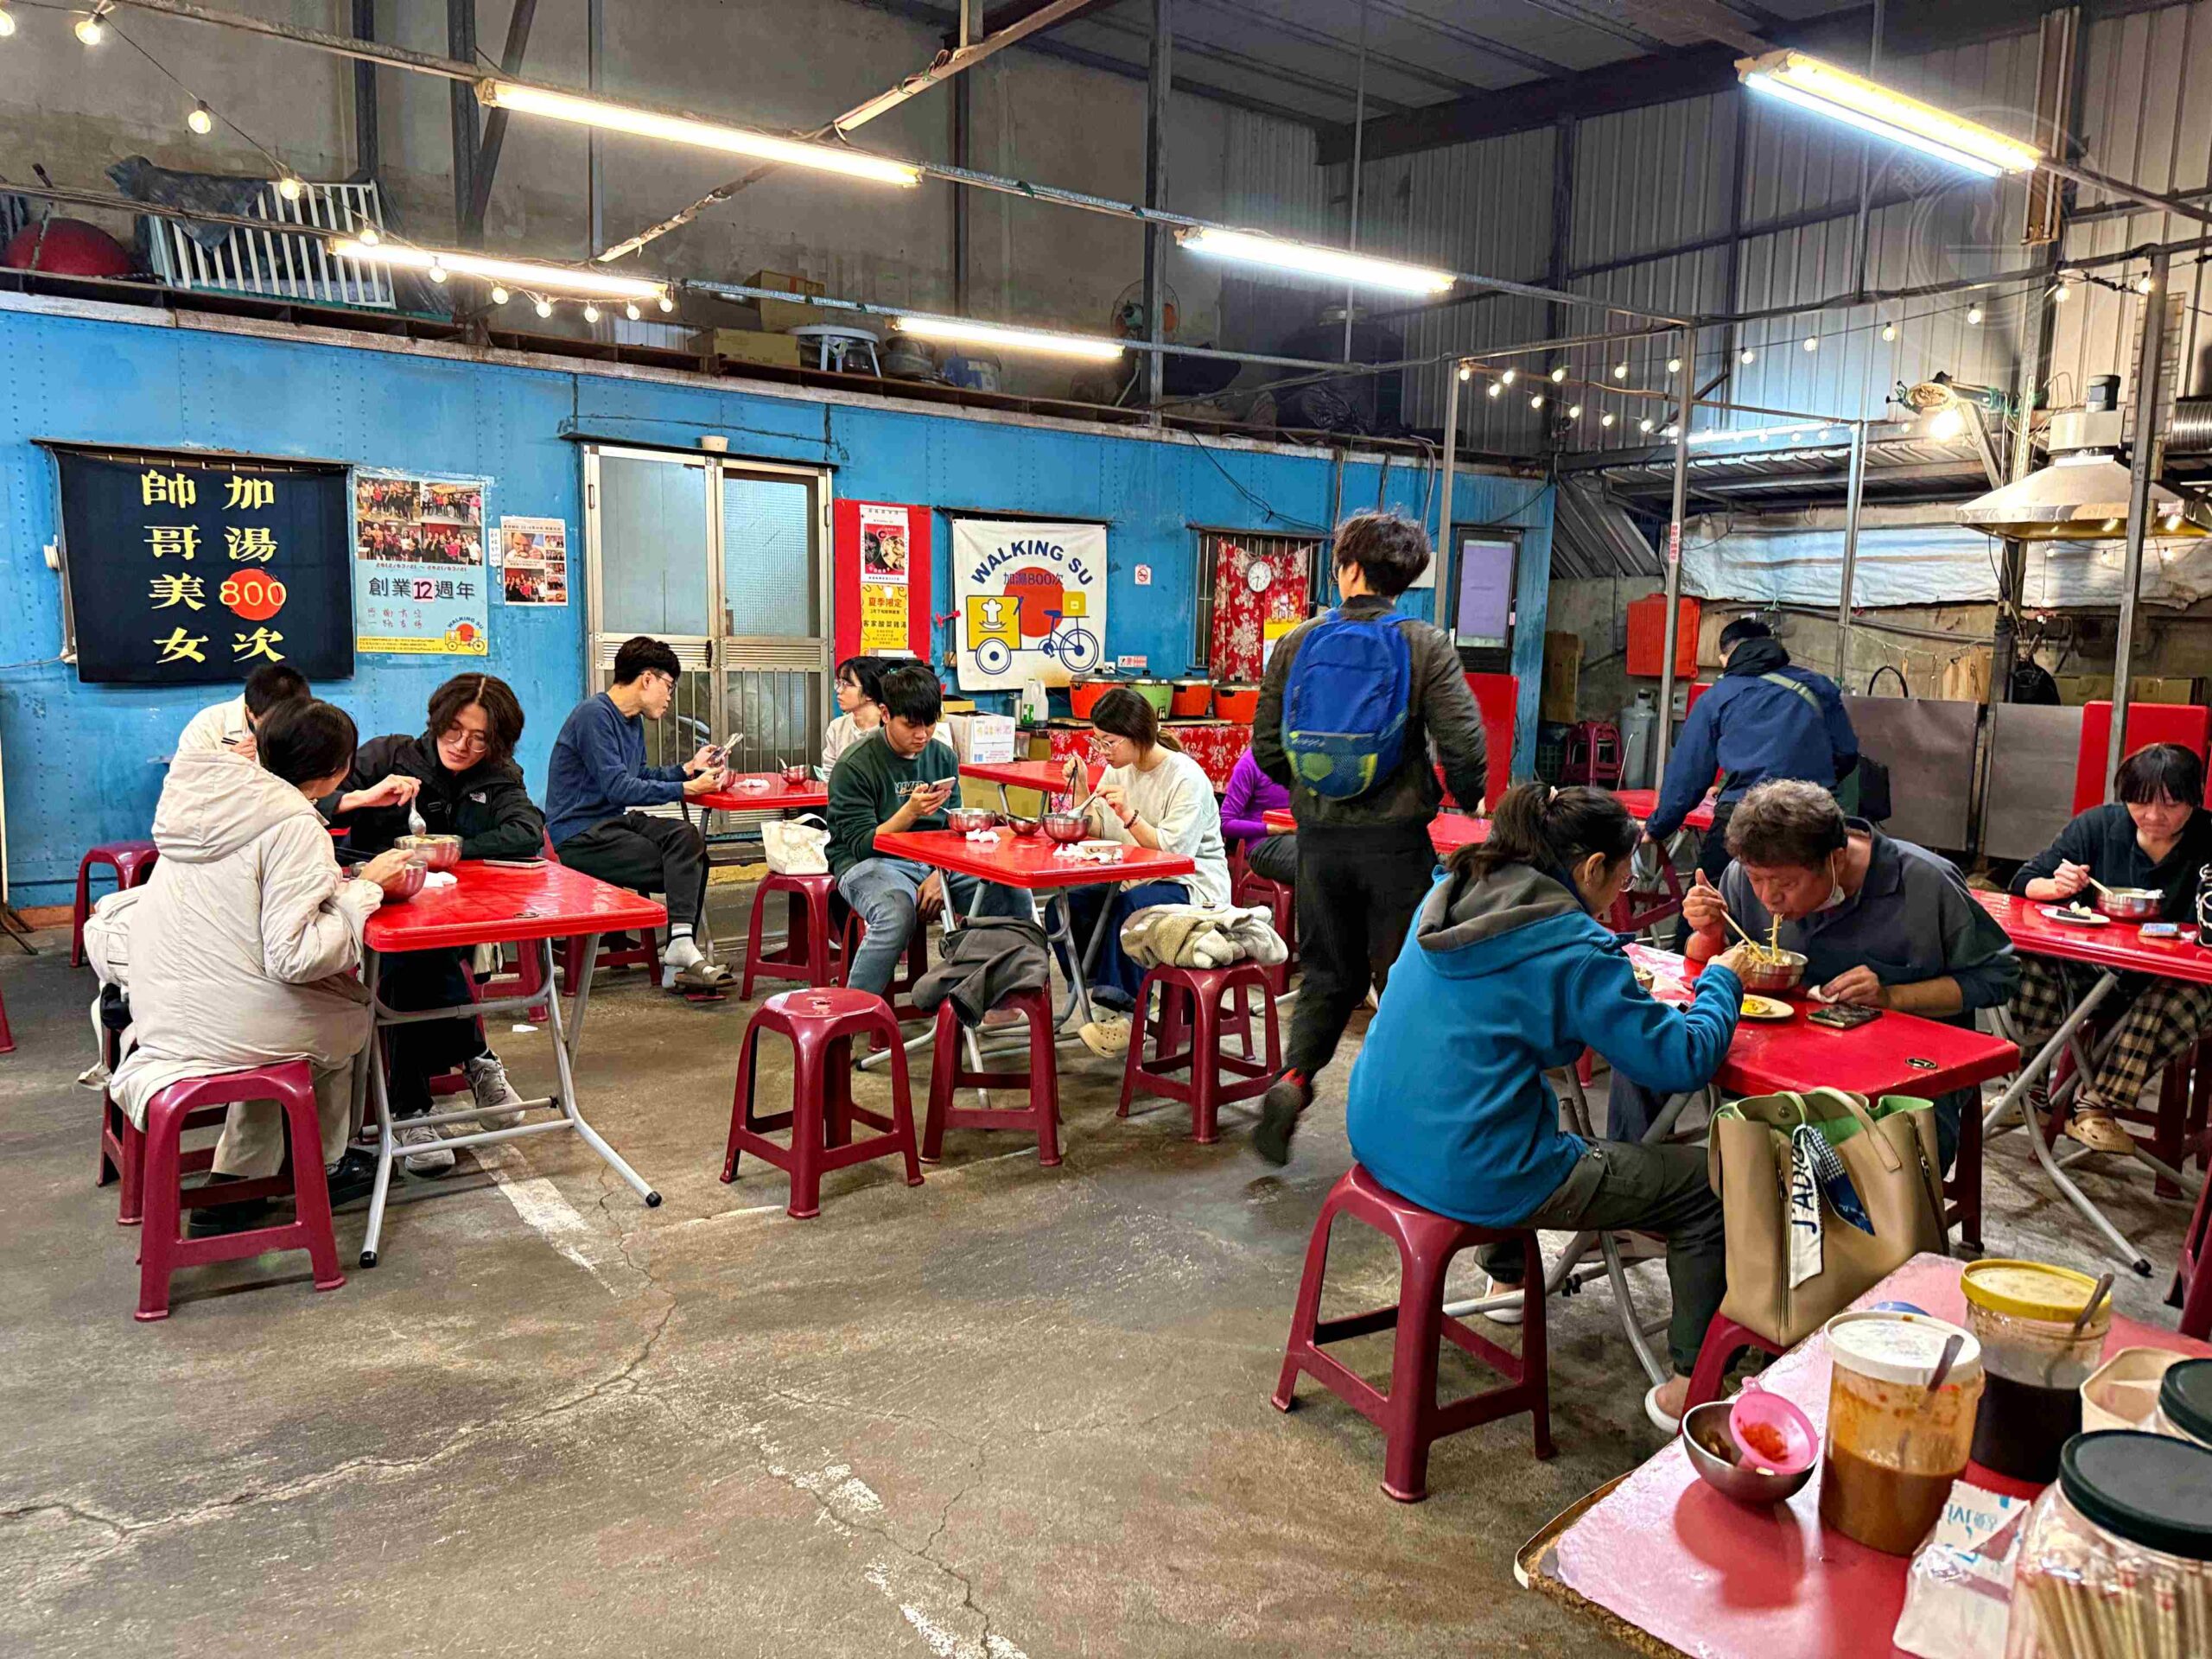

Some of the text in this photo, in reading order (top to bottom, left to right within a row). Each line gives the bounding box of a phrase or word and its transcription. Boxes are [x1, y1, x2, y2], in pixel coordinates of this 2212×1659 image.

[141, 469, 209, 664] 帥哥美女
[971, 540, 1094, 586] WALKING SU
[369, 577, 475, 601] 創業12週年
[448, 616, 475, 628] WALKING
